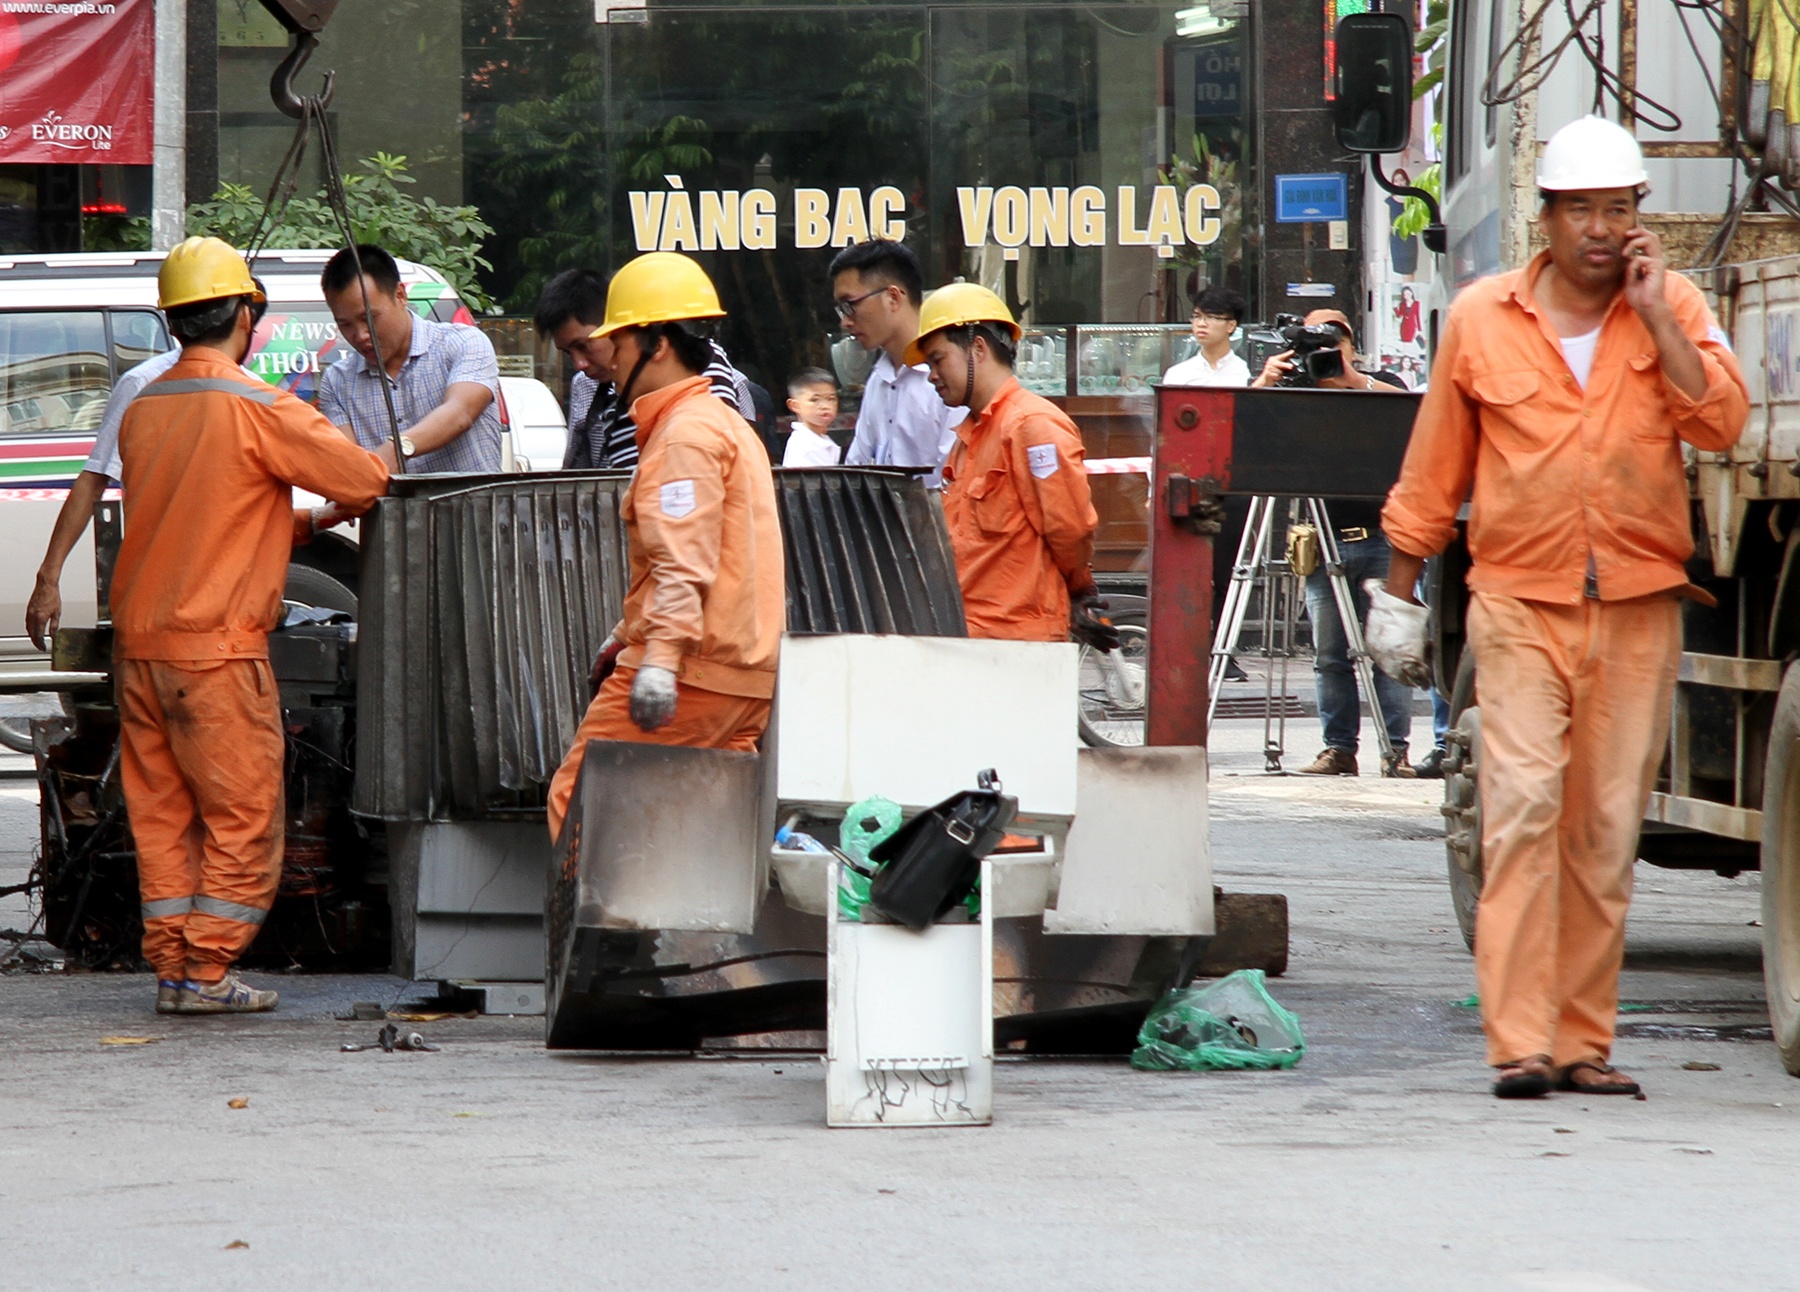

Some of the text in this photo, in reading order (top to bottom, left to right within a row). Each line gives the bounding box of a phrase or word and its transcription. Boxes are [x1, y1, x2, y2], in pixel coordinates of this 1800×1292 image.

[2, 1, 115, 16] www.everpia.vn
[31, 124, 112, 141] EVERON
[92, 140, 112, 150] Lite
[628, 174, 777, 253] VÀNG
[956, 185, 1106, 261] VỌNG
[1118, 183, 1221, 258] LẠC
[271, 322, 337, 341] NEWS
